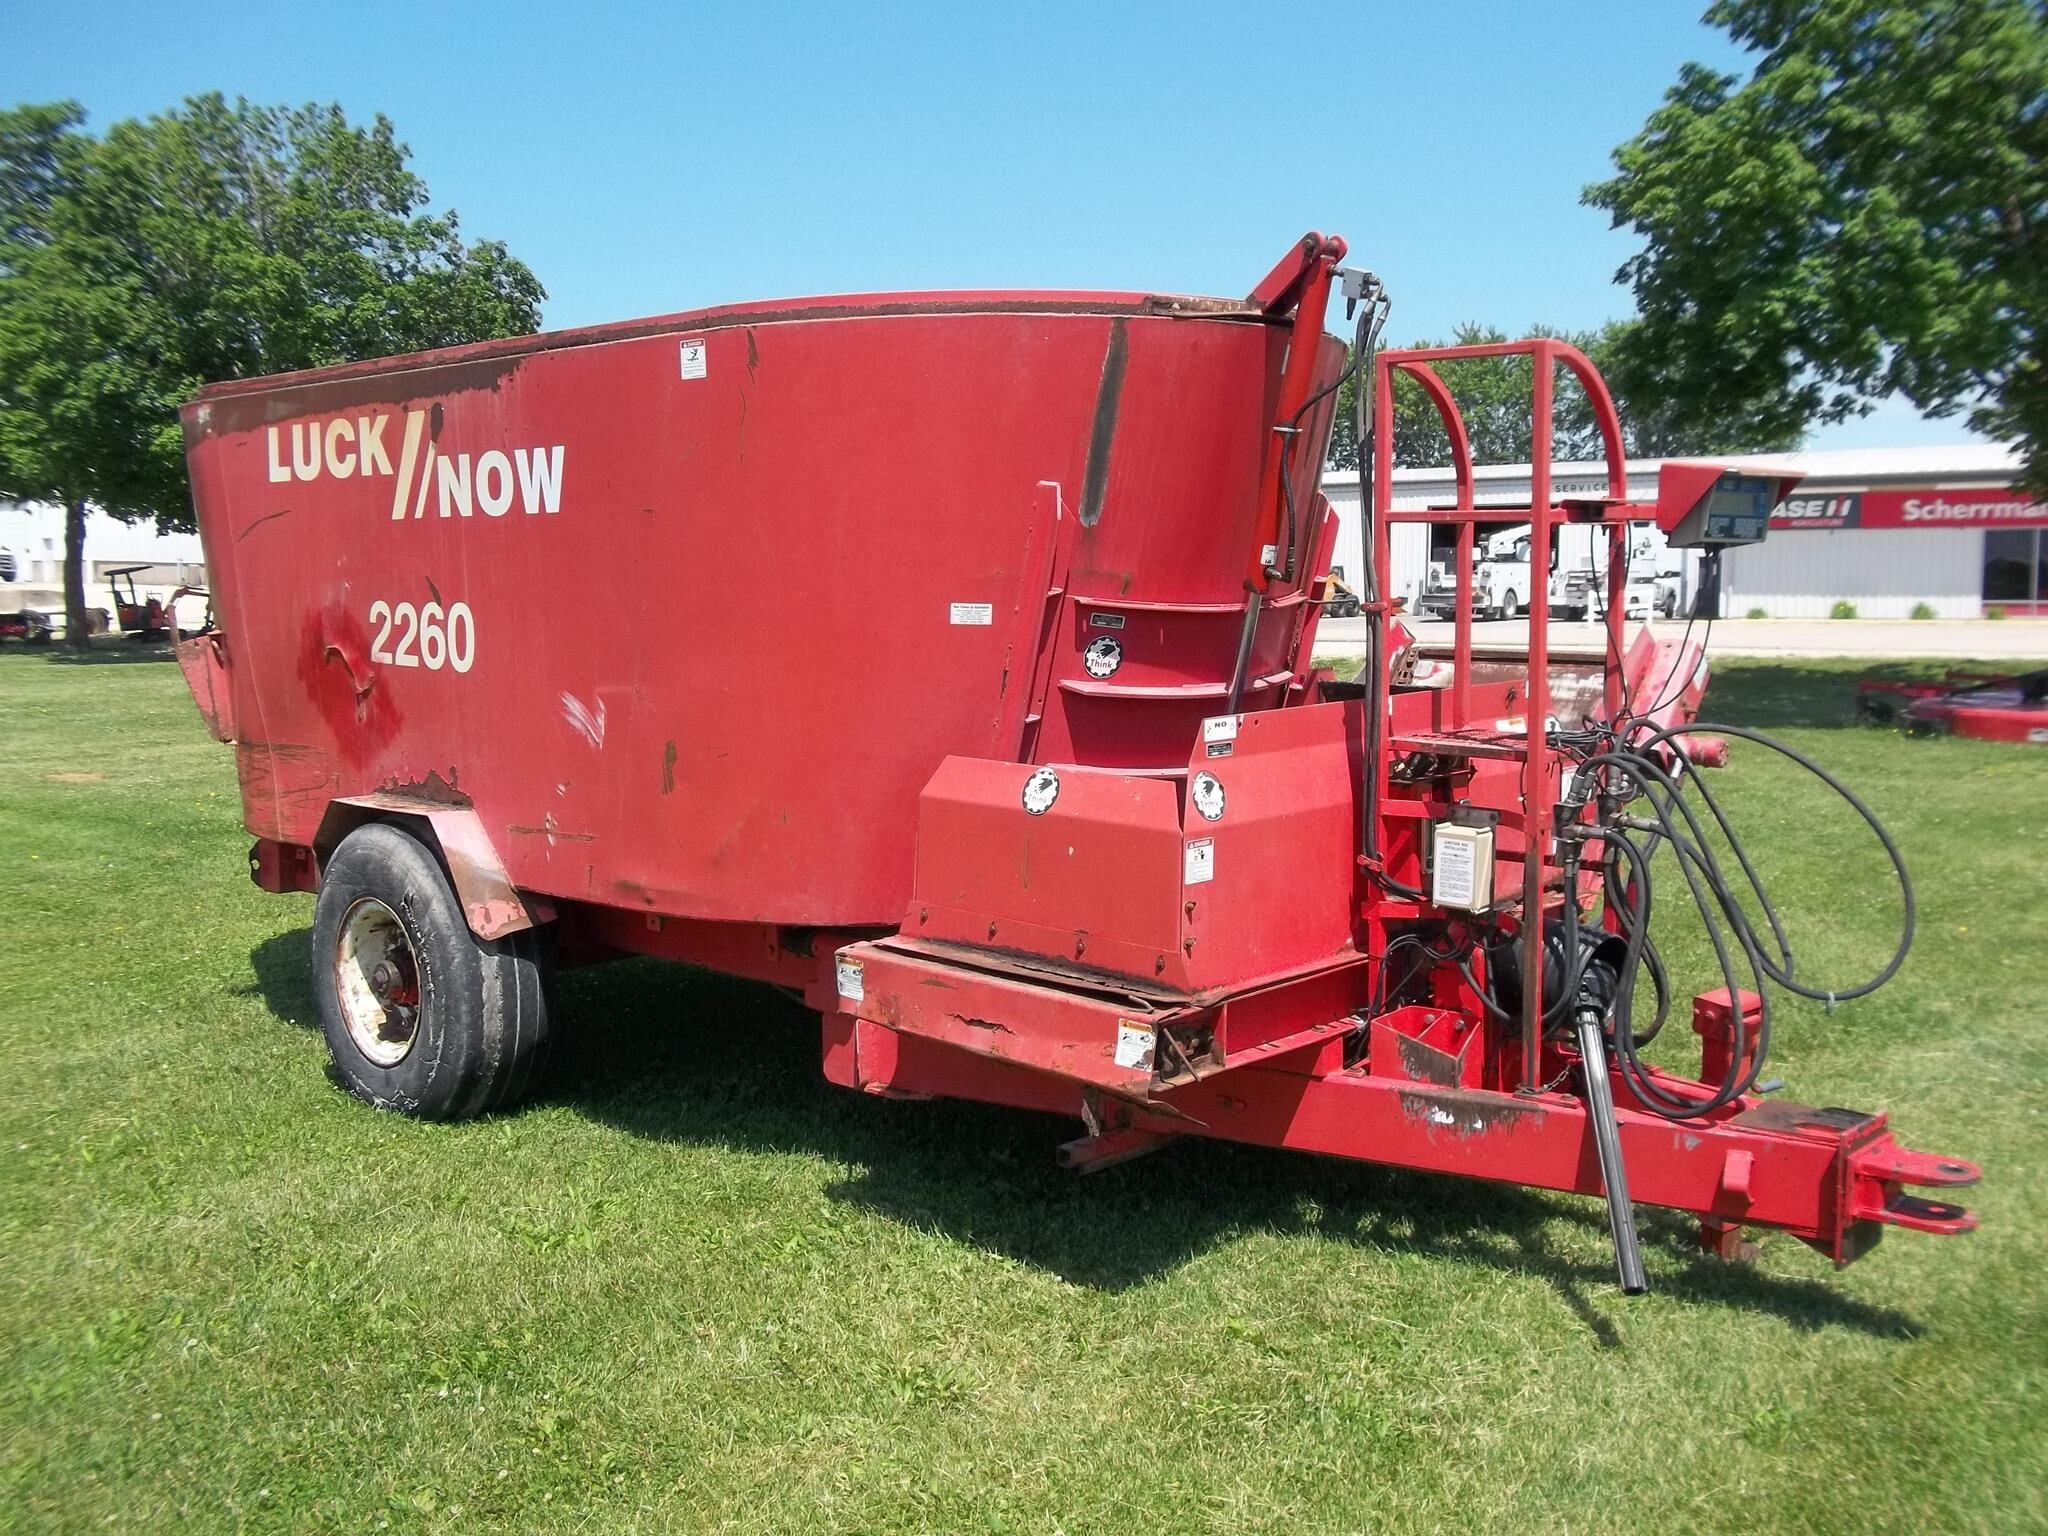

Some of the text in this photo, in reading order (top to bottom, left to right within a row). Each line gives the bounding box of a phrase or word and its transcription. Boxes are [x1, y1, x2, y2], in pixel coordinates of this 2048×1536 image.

[267, 414, 565, 518] LUCK NOW
[1555, 483, 1609, 493] SERVICE
[1769, 499, 1826, 518] ASE
[369, 599, 475, 673] 2260
[1090, 658, 1113, 669] Think
